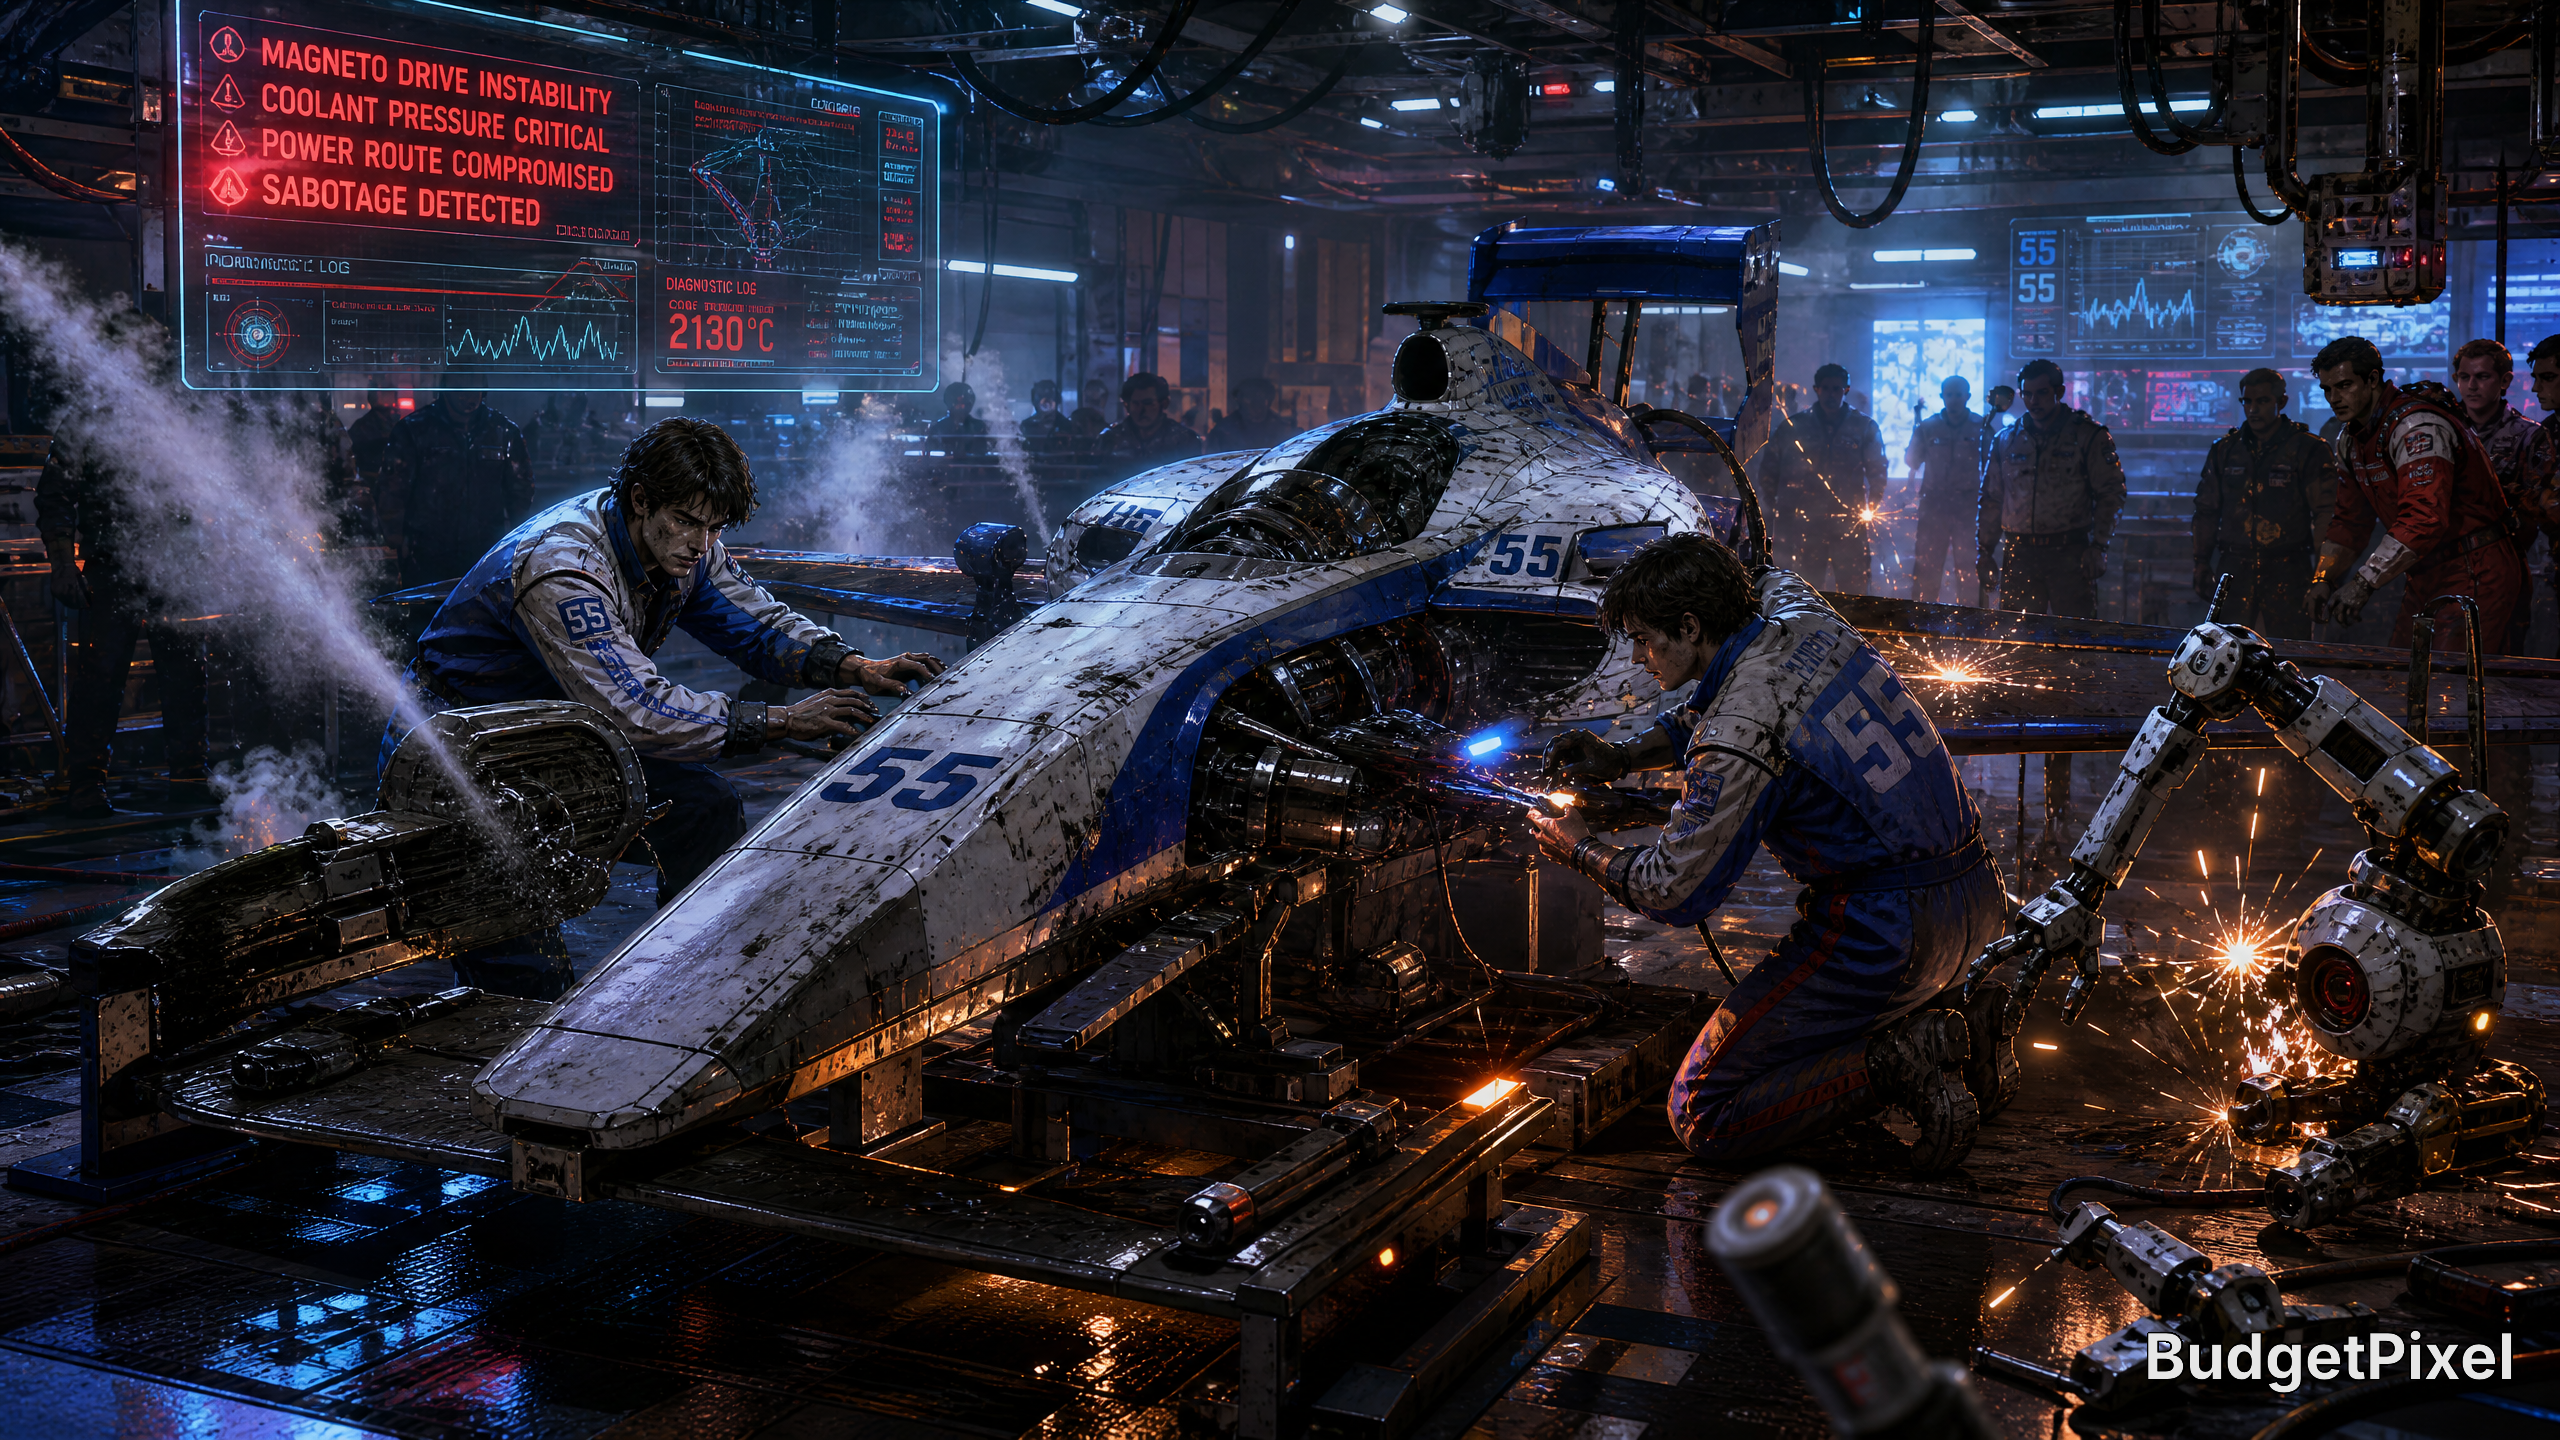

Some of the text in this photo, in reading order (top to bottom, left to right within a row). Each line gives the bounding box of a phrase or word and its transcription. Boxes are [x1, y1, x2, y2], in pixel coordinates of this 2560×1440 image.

[261, 37, 612, 115] MAGNETO DRIVE INSTABILITY
[261, 82, 610, 154] COOLANT PRESSURE CRITICAL
[261, 128, 614, 193] POWER ROUTE COMPROMISED
[261, 172, 540, 227] SABOTAGE DETECTED
[2019, 237, 2056, 266] 55
[666, 276, 757, 295] DIAGNOSTIC LOG
[2018, 273, 2056, 303] 55
[669, 313, 774, 352] 2130°C
[1489, 534, 1562, 578] 55
[565, 602, 607, 634] 55
[1821, 661, 1940, 795] 55
[819, 746, 1004, 813] 55
